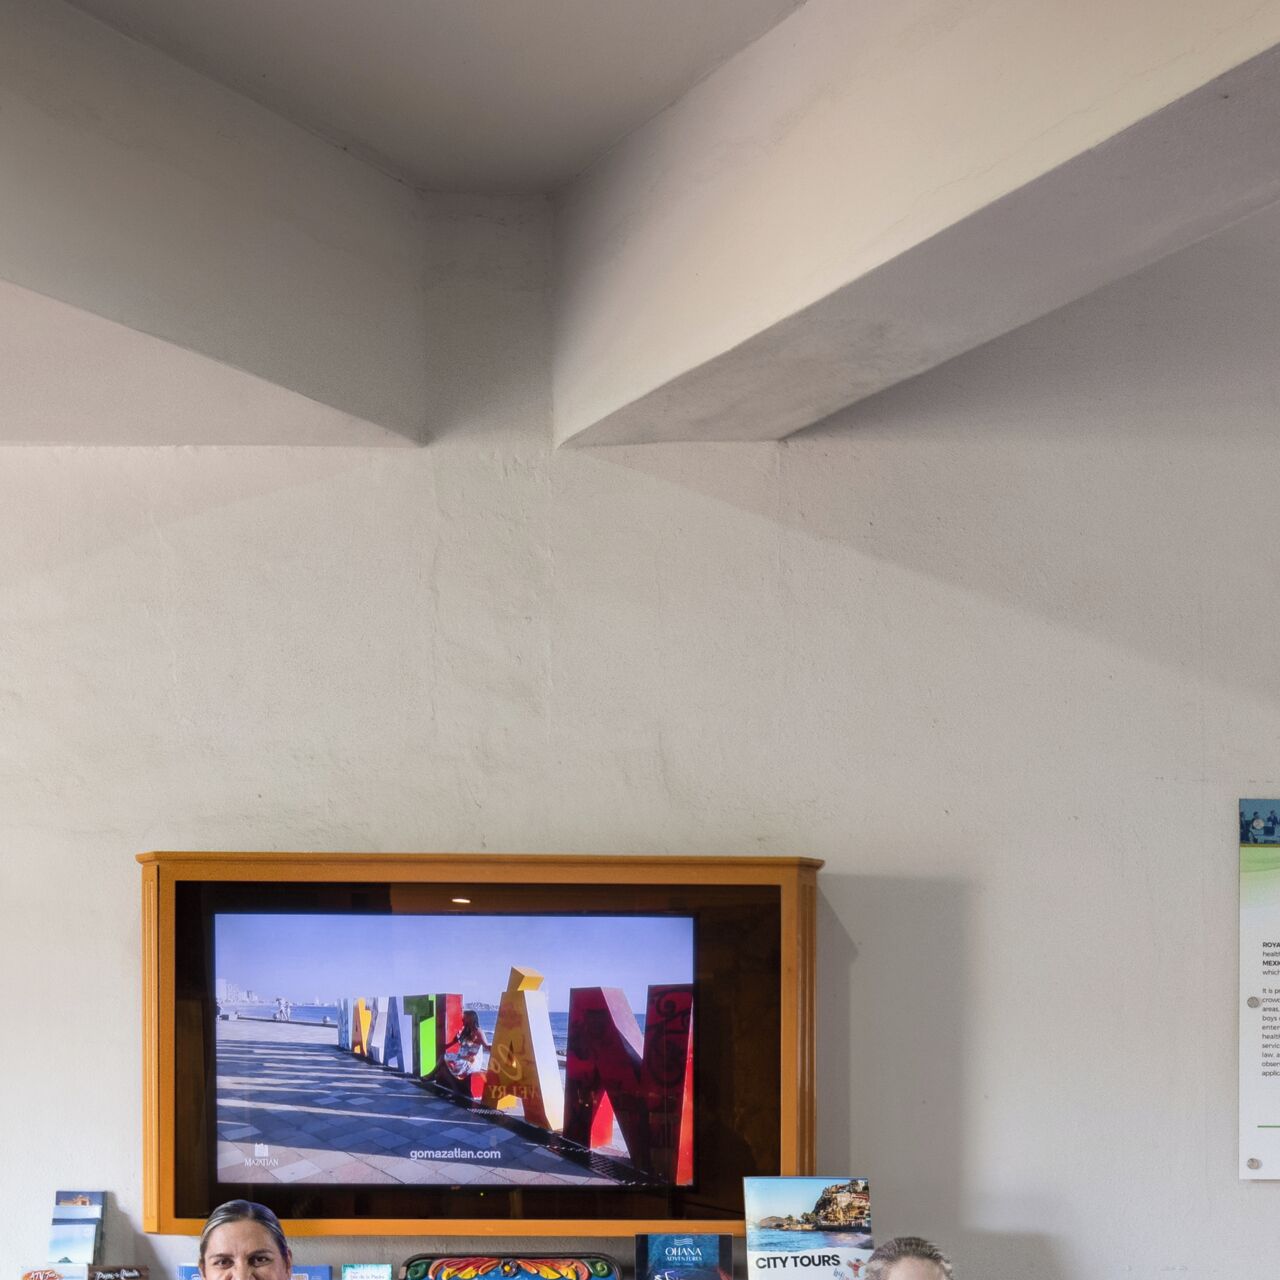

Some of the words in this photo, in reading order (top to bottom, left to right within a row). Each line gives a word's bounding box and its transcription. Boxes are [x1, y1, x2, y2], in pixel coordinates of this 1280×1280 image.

[410, 1148, 501, 1161] gomazatlan.com
[665, 1247, 702, 1256] OHANA
[755, 1257, 792, 1270] CITY
[791, 1254, 841, 1268] TOURS
